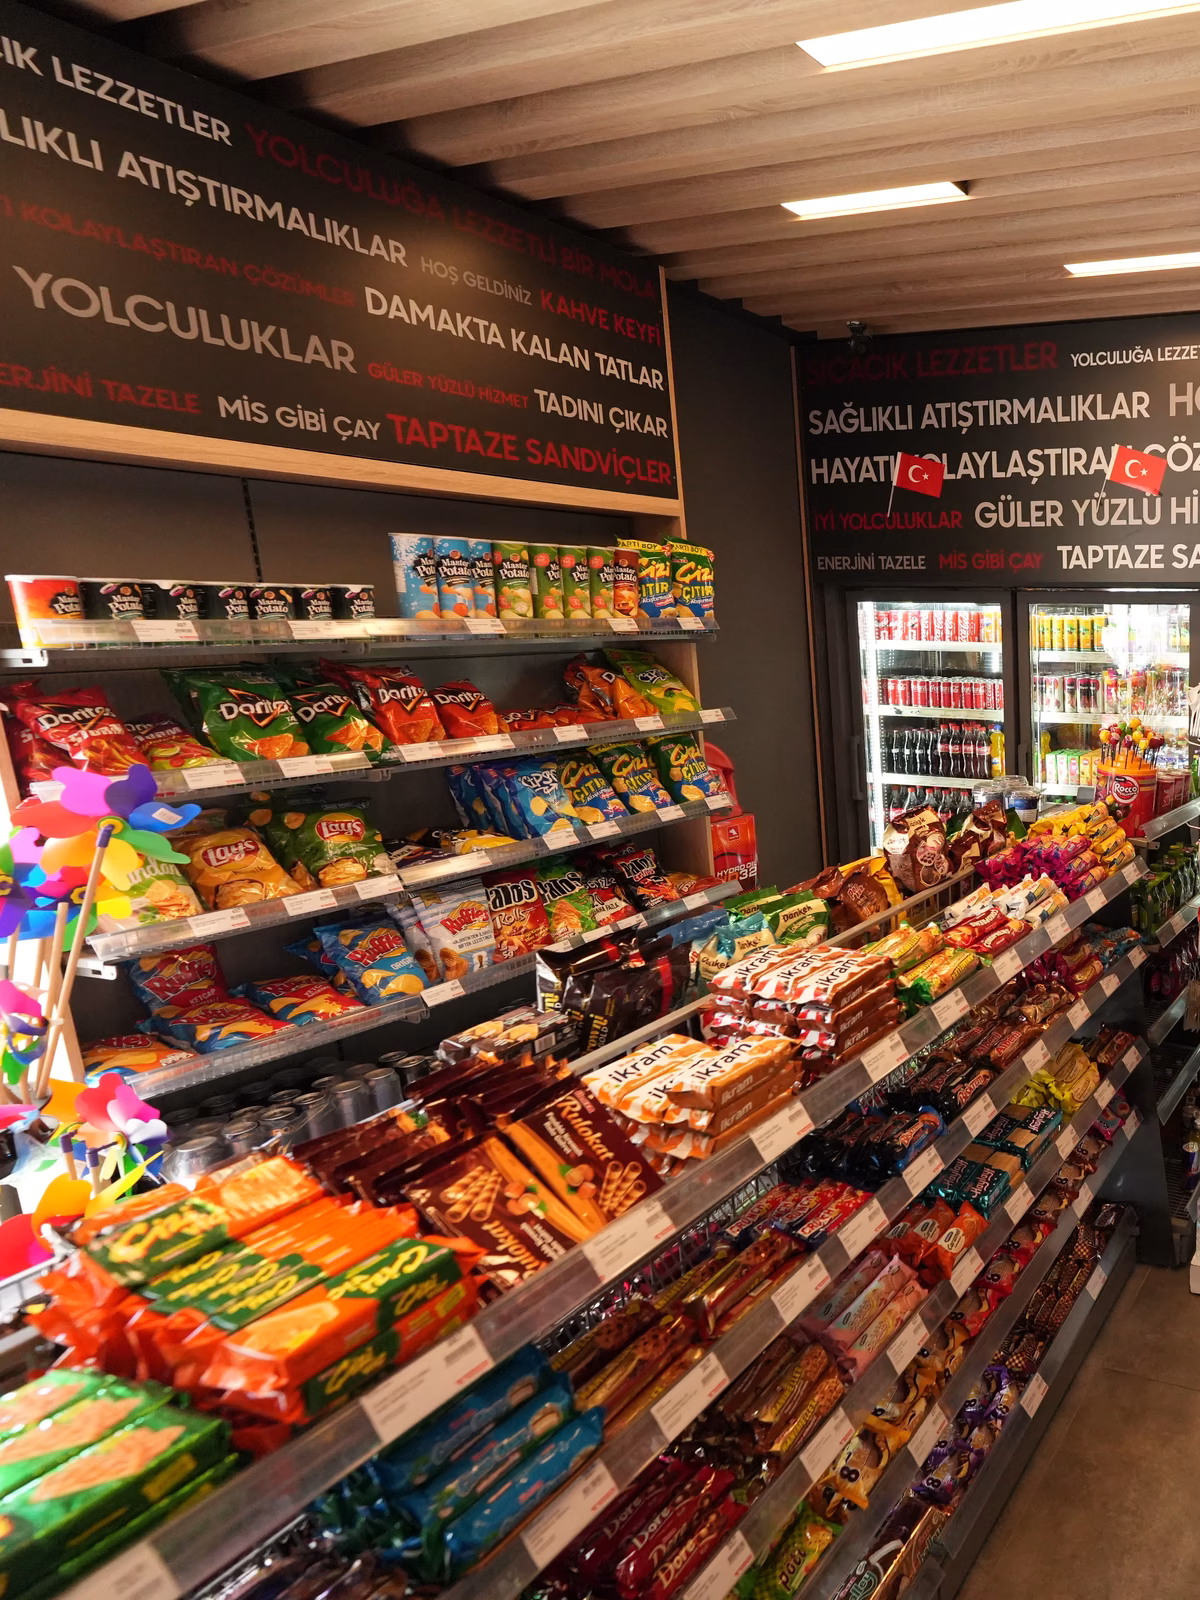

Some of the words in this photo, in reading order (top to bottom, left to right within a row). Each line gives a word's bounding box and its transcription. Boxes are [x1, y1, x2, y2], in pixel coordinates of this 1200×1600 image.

[0, 36, 44, 76] IK
[52, 56, 232, 146] LEZZETLER
[117, 150, 408, 268] ATIŞTIRMALIKLAR
[421, 256, 460, 285] HOŞ
[462, 270, 533, 307] GELDİNİZ
[539, 289, 609, 333] KAHVE
[613, 306, 662, 348] KEYFİ
[20, 202, 240, 279] KOLAYLAŞTIRAN
[365, 286, 506, 349] DAMAKTA
[511, 328, 590, 372] KALAN
[595, 351, 665, 392] TATLAR
[12, 264, 358, 374] YOLCULUKLAR
[367, 361, 423, 388] GÜLER
[427, 373, 475, 399] YÜZLÜ
[478, 385, 529, 409] HİZMET
[534, 388, 604, 425] TADINI
[608, 406, 669, 438] ÇIKAR
[915, 341, 1059, 379] LEZZETLER
[1070, 345, 1154, 368] YOLCULUĞA
[808, 401, 914, 436] SAĞLIKLI
[919, 391, 1151, 436] ATIŞTIRMALIKLAR
[101, 378, 202, 415] TAZELE
[217, 394, 269, 425] MİS
[275, 403, 326, 432] GİBİ
[332, 415, 381, 442] ÇAY
[386, 412, 520, 462] TAPTAZE
[525, 437, 673, 486] SANDVİÇLER
[912, 443, 1131, 486] LAYLAŞTIRA
[839, 510, 964, 531] YOLCULUKLAR
[974, 494, 1064, 529] GÜLER
[1071, 491, 1163, 528] YÜZLÜ
[438, 565, 472, 578] Potato
[441, 557, 470, 568] Master
[499, 568, 530, 580] Potato
[501, 561, 528, 570] Master
[816, 551, 876, 572] ENERJİNİ
[878, 554, 927, 571] TAZELE
[938, 548, 968, 571] MİS
[971, 549, 1007, 571] GİBİ
[1008, 552, 1045, 575] ÇAY
[1056, 543, 1165, 570] TAPTAZE
[254, 604, 289, 614] Potato
[257, 598, 285, 606] Master
[37, 705, 117, 730] Doritos
[1113, 783, 1139, 797] Rocco
[320, 818, 364, 842] Lay's
[205, 837, 260, 867] Lay's
[716, 863, 744, 878] HYDRO
[440, 906, 490, 936] Ruffles
[781, 904, 813, 923] Dankek
[345, 933, 404, 968] Ruffle
[734, 948, 780, 978] ikram
[779, 952, 822, 981] ikram
[817, 957, 859, 987] ikram
[843, 1026, 870, 1049] ikram
[995, 1030, 1022, 1055] Albeni
[610, 1042, 675, 1085] ikram
[690, 1041, 753, 1085] ikram
[719, 1074, 754, 1104] ikram
[556, 1095, 616, 1161] Rulokat
[719, 1101, 754, 1132] ikram
[632, 1506, 673, 1550] Dore
[653, 1539, 698, 1590] Dore
